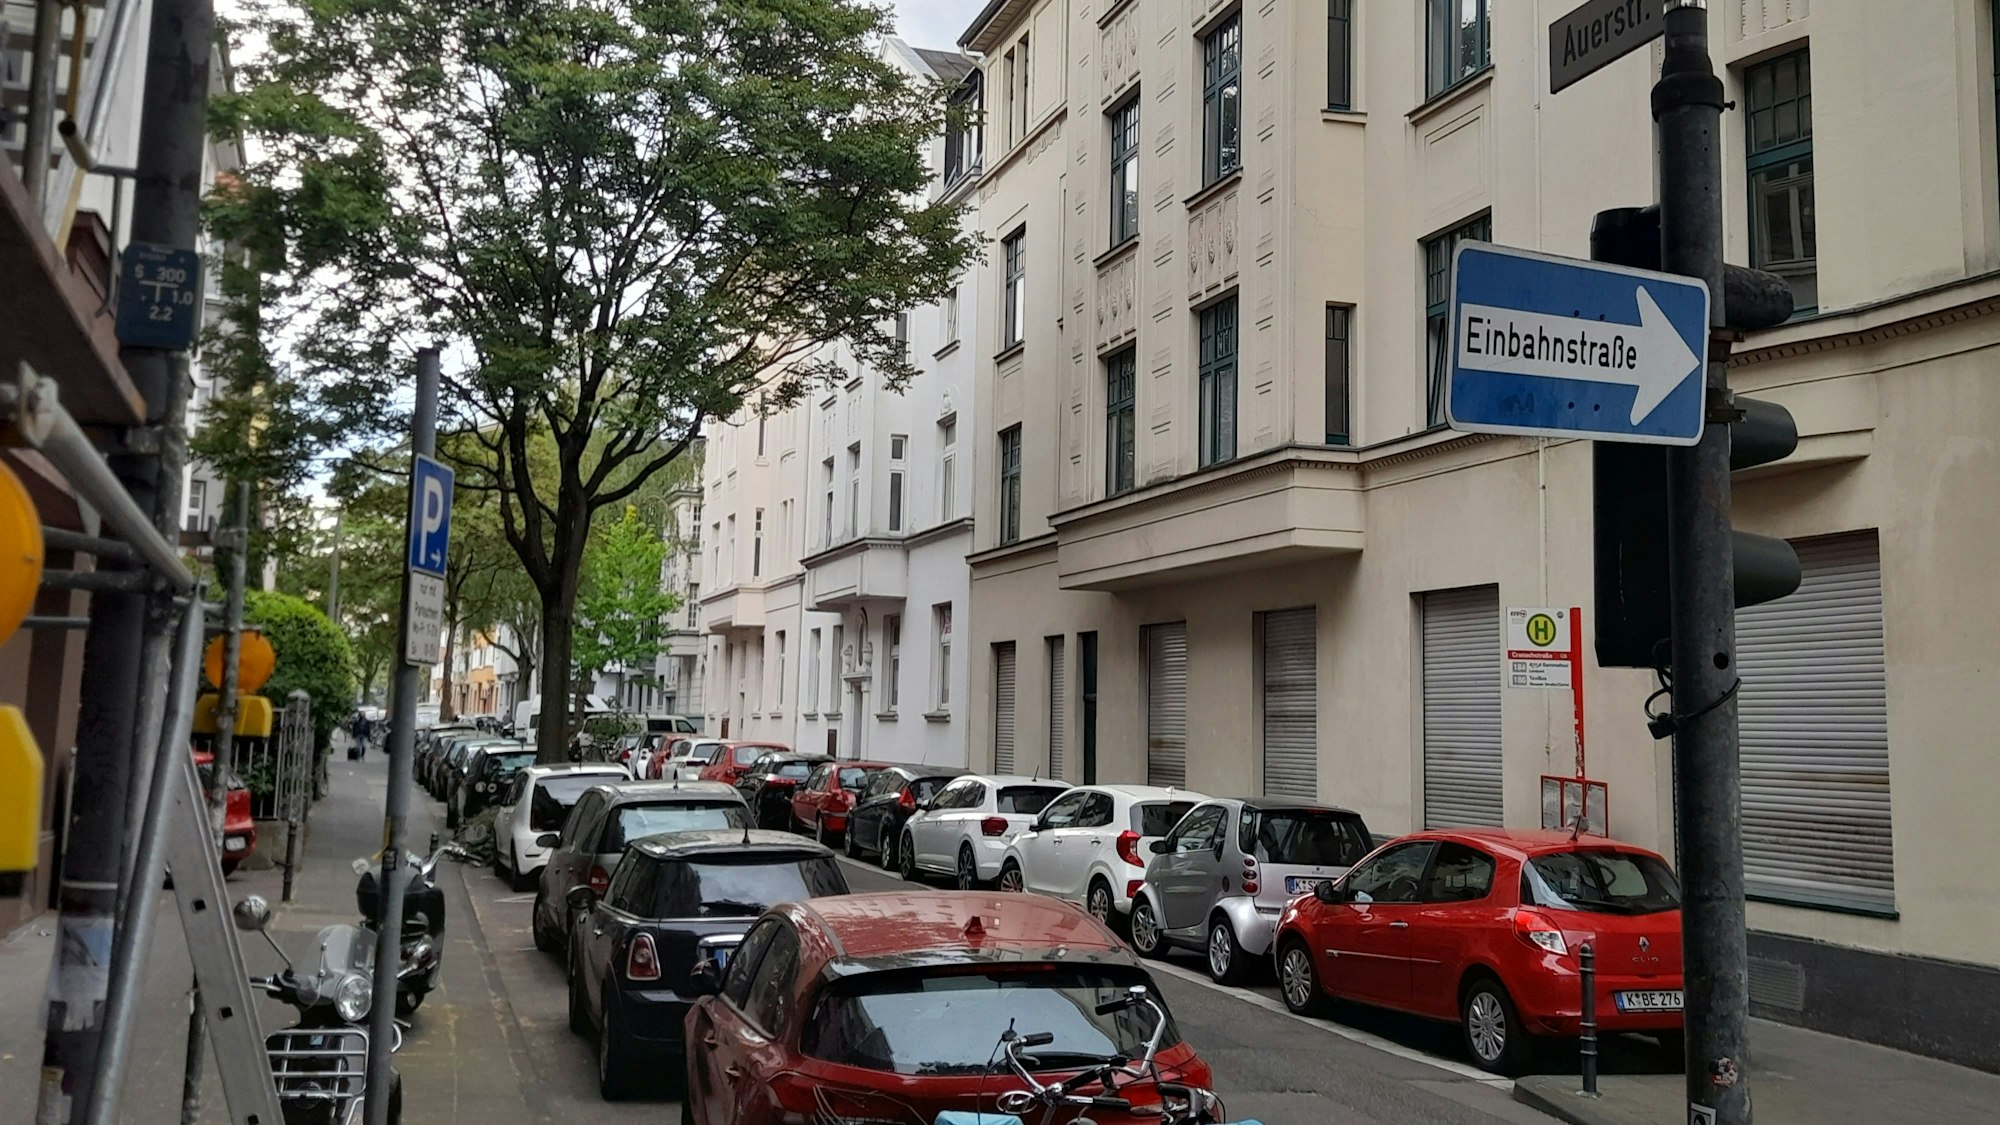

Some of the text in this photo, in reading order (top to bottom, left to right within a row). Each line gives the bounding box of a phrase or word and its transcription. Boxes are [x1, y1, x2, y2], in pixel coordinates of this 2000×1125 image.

[1563, 0, 1651, 67] Auerstr.
[172, 290, 194, 305] 1.0
[149, 305, 173, 321] 2.2
[1466, 316, 1637, 370] Einbahnstraße
[419, 475, 443, 566] P
[1534, 620, 1548, 641] H
[1295, 880, 1302, 890] K
[1626, 993, 1681, 1007] K BE 276
